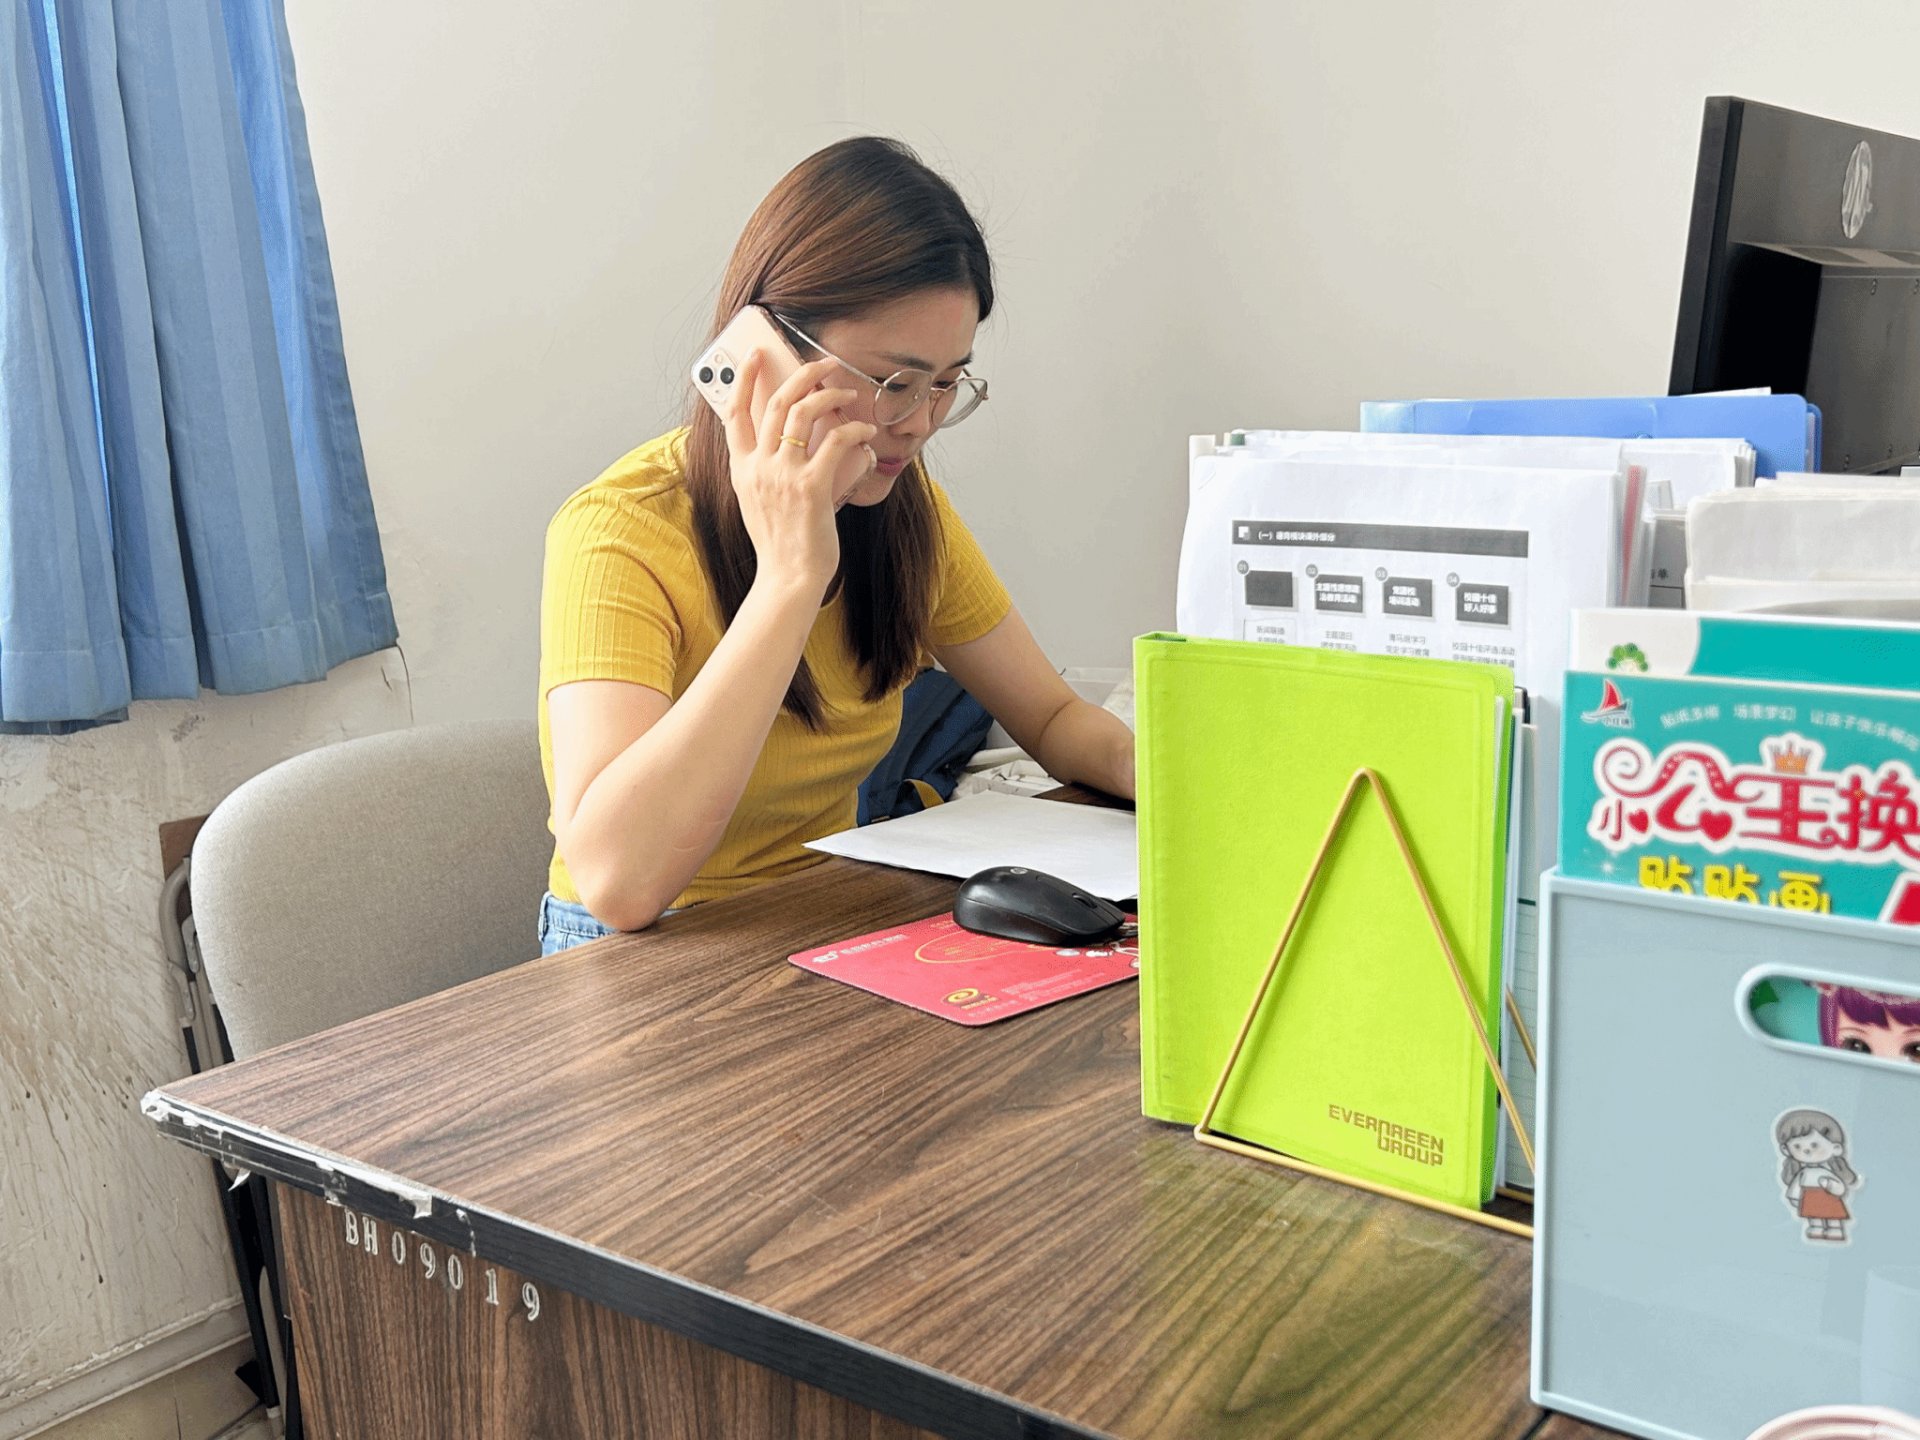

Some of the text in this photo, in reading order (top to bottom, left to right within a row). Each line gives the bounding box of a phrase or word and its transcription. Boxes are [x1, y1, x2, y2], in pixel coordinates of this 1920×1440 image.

[1463, 592, 1497, 604] 校园十佳
[1463, 603, 1497, 614] 好人好事
